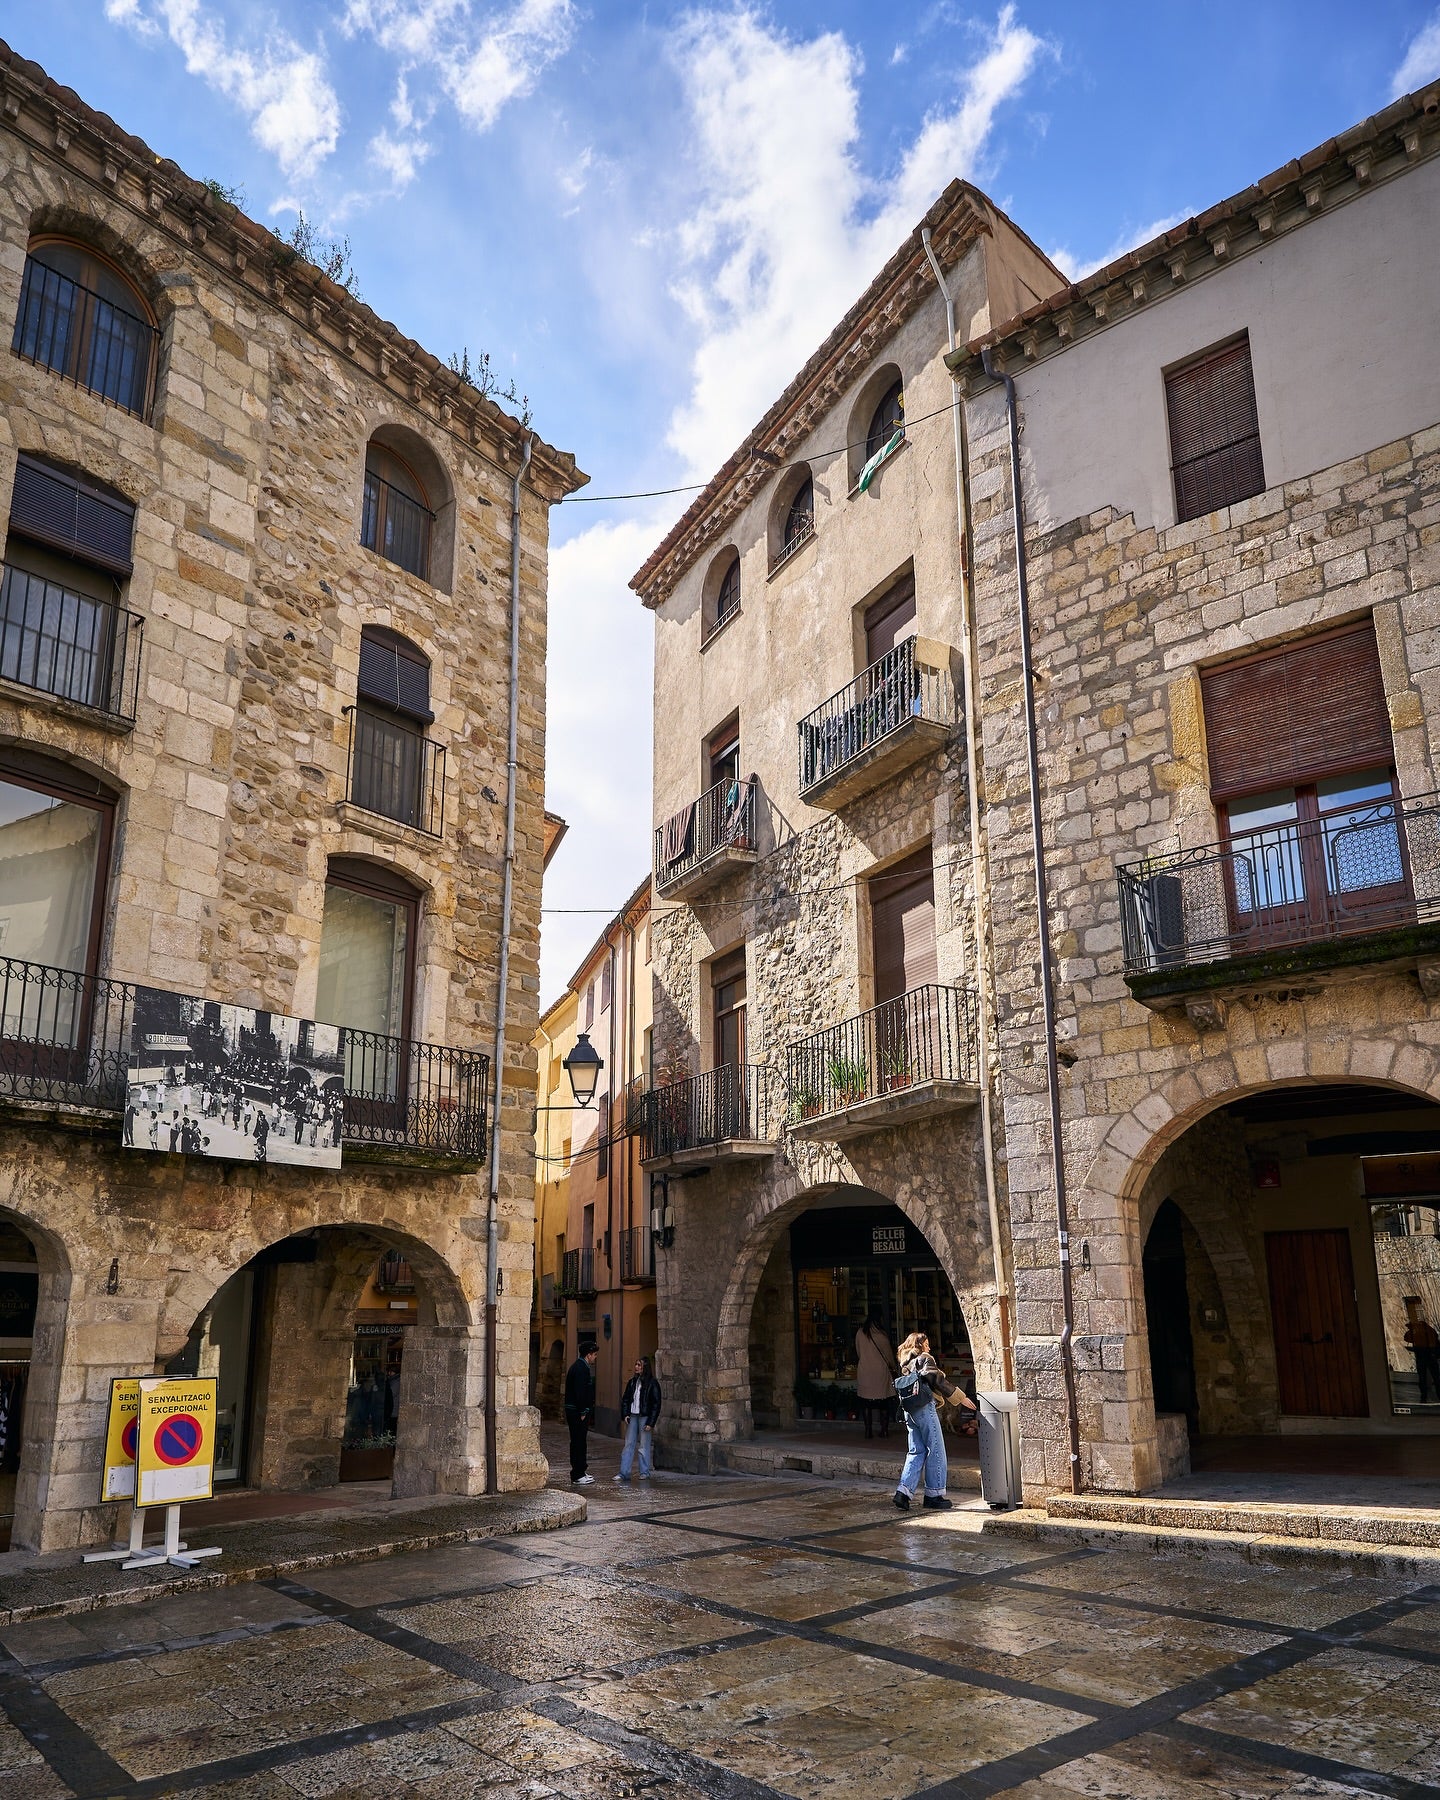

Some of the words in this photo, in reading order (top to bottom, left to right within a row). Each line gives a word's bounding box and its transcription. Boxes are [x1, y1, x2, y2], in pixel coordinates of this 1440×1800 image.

[872, 1229, 906, 1240] CELLER
[872, 1239, 906, 1252] BESALÚ
[148, 1392, 211, 1404] SENYALITZACIÓ
[151, 1405, 208, 1415] EXCEPCIONAL
